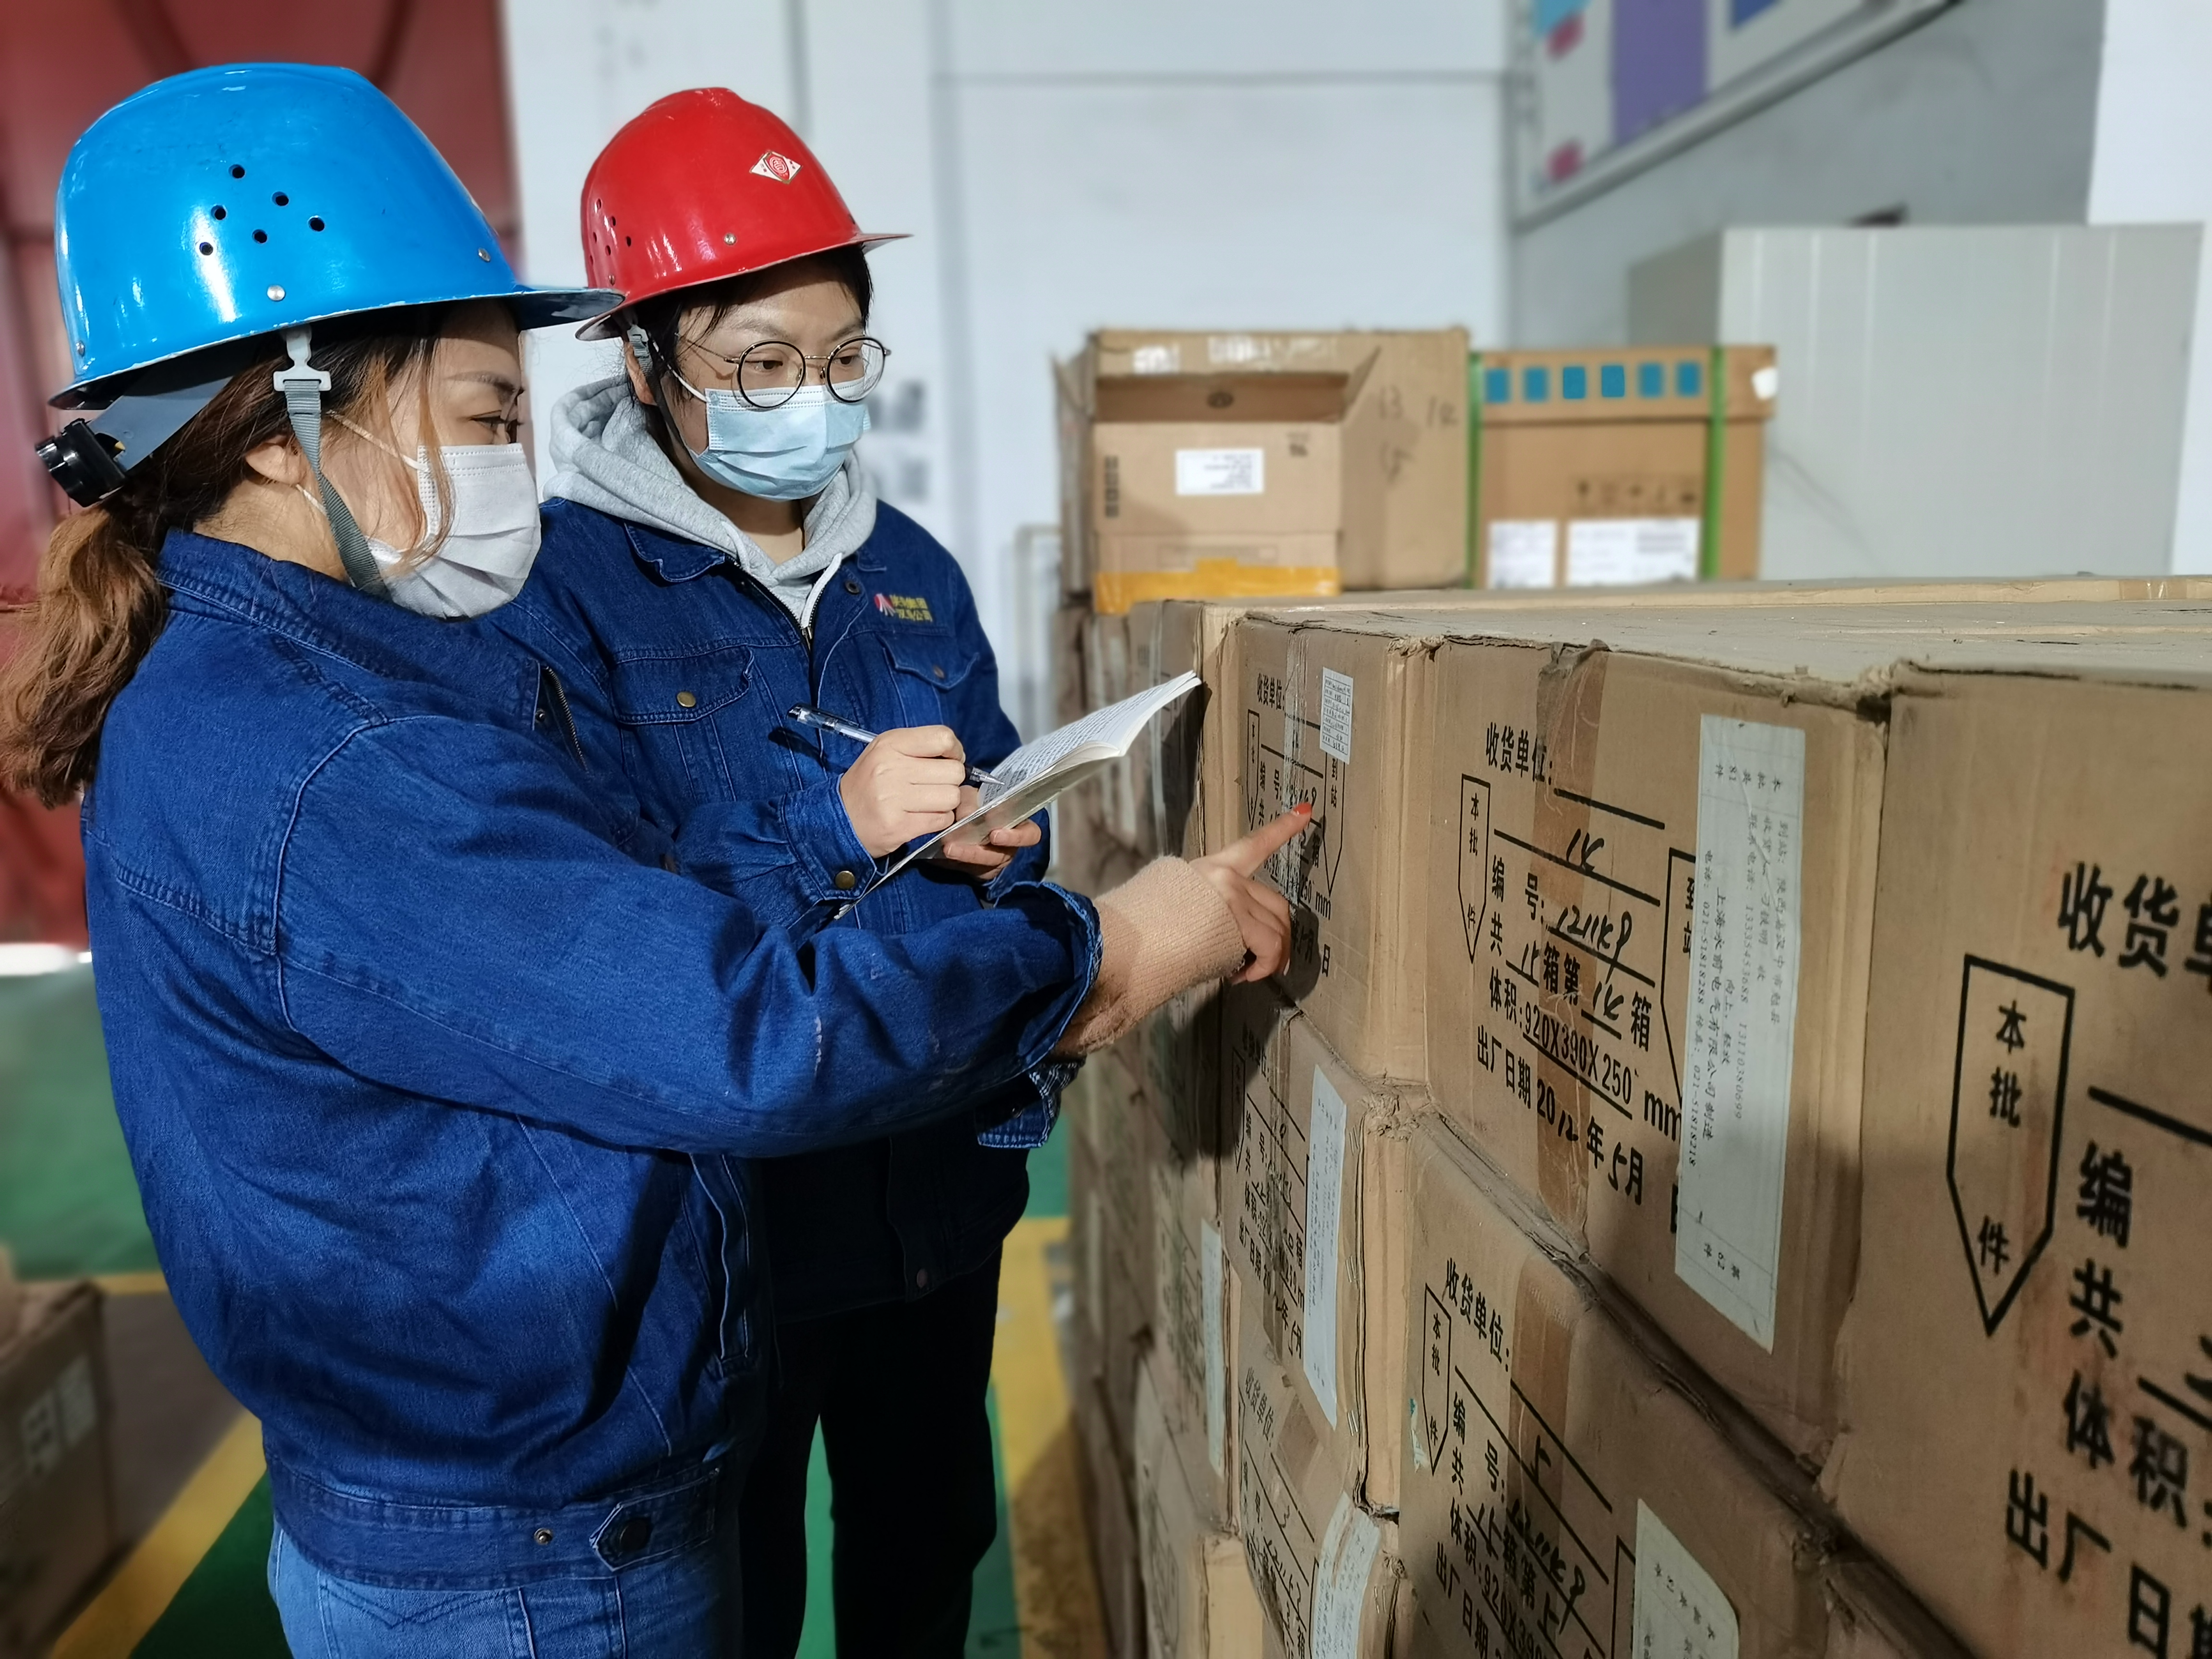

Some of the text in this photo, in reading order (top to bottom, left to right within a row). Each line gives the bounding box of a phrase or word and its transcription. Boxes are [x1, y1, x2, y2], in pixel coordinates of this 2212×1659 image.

[1486, 721, 1553, 785] 收货单位:
[1315, 886, 1331, 922] mm
[2076, 1140, 2133, 1249] 编
[1446, 1257, 1510, 1372] 收货单位:
[2069, 1258, 2124, 1359] 共
